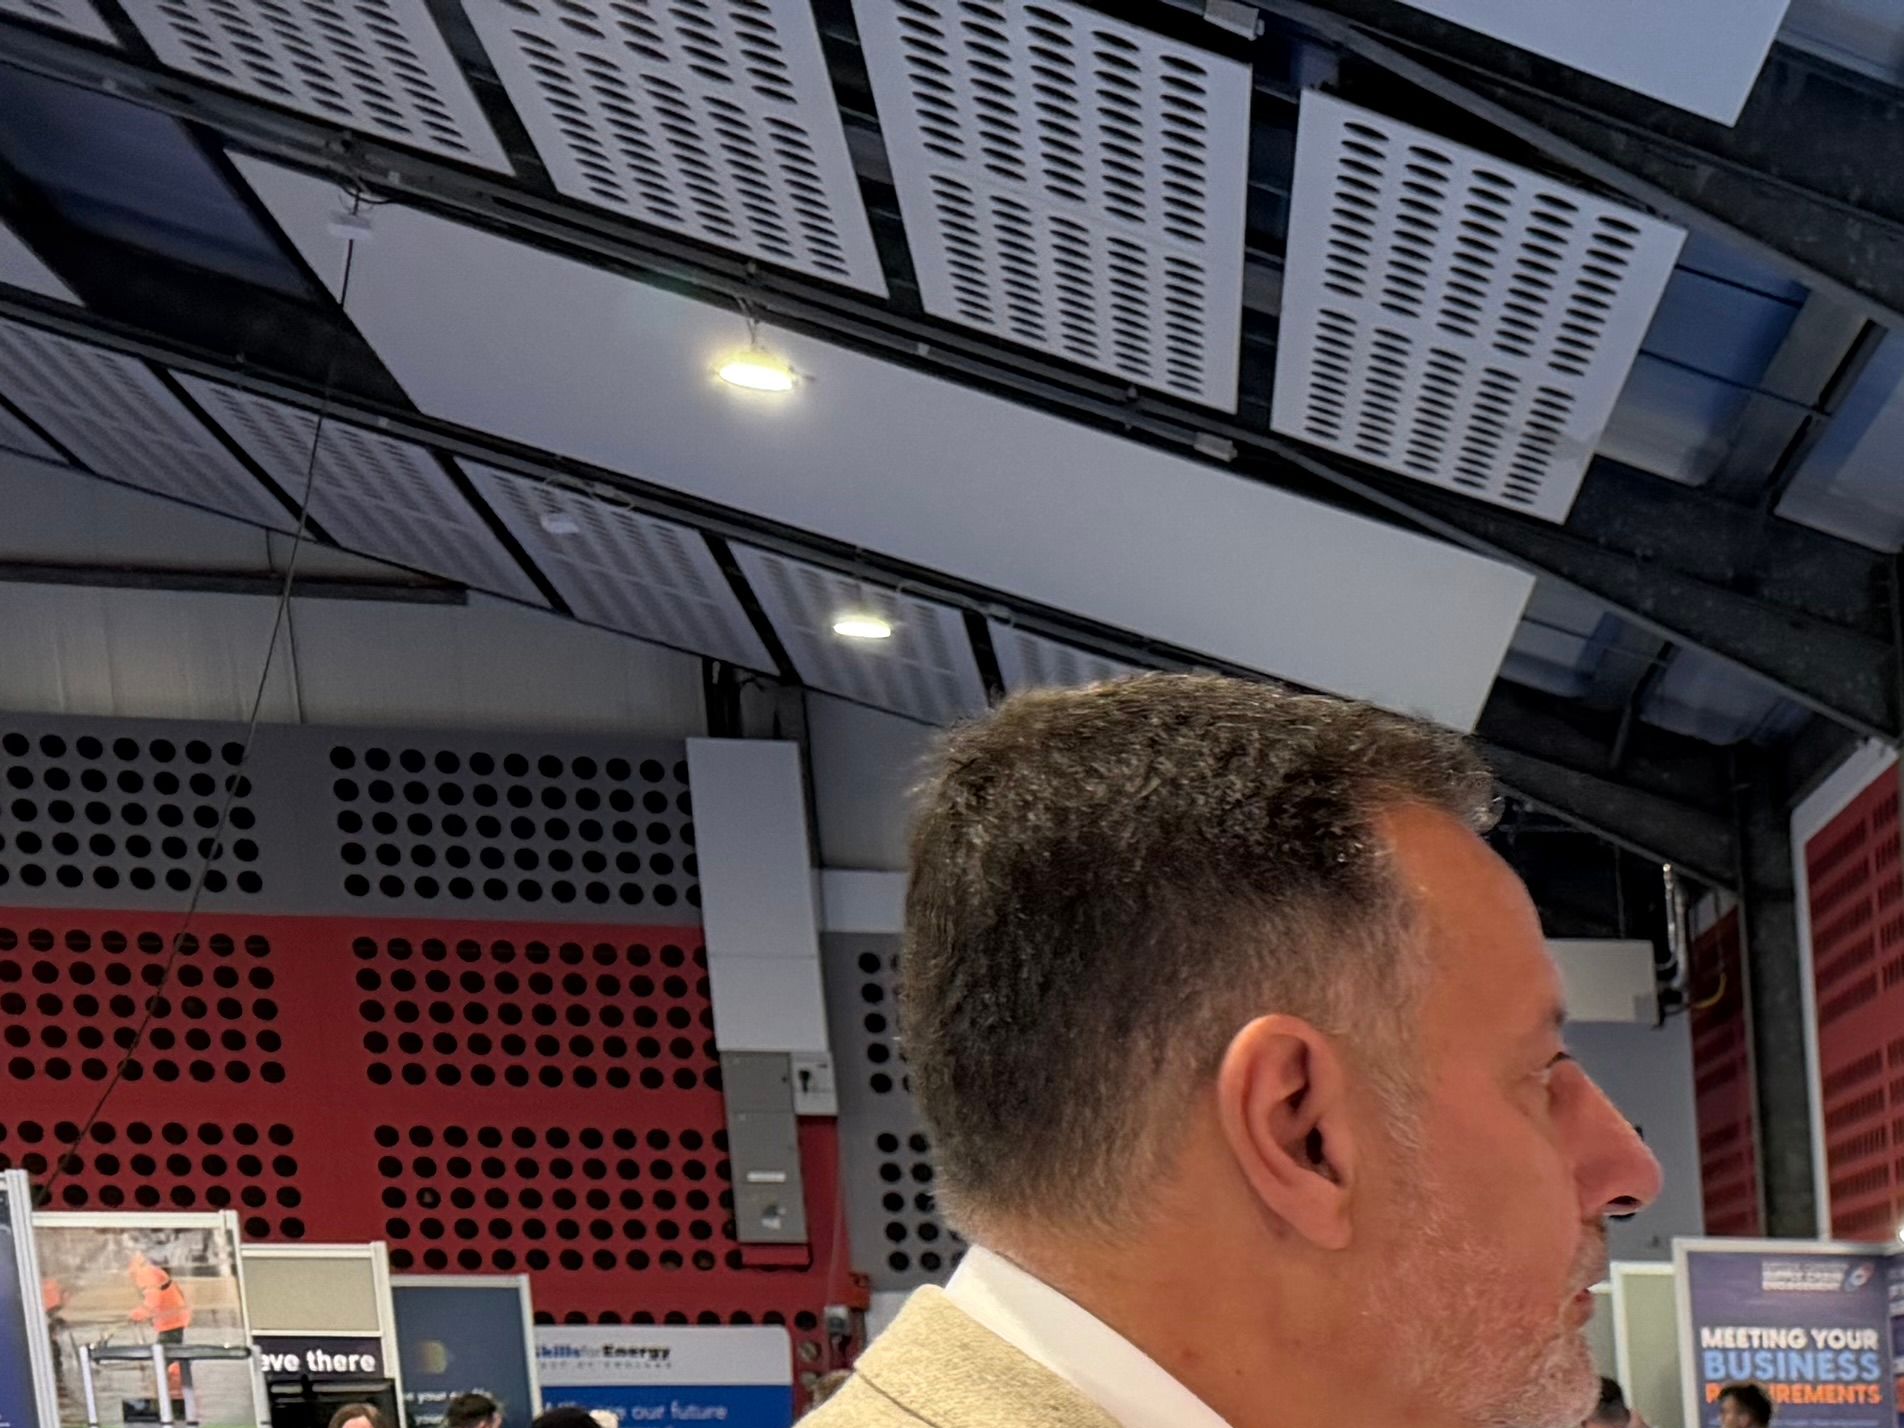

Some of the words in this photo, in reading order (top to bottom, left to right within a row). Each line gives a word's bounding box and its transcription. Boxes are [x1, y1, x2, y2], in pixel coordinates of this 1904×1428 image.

[1701, 1326, 1809, 1349] MEETING
[1810, 1327, 1880, 1350] YOUR
[306, 1349, 376, 1372] there
[1703, 1351, 1882, 1382] BUSINESS
[1705, 1383, 1883, 1405] RIREMENTS
[670, 1400, 728, 1421] future
